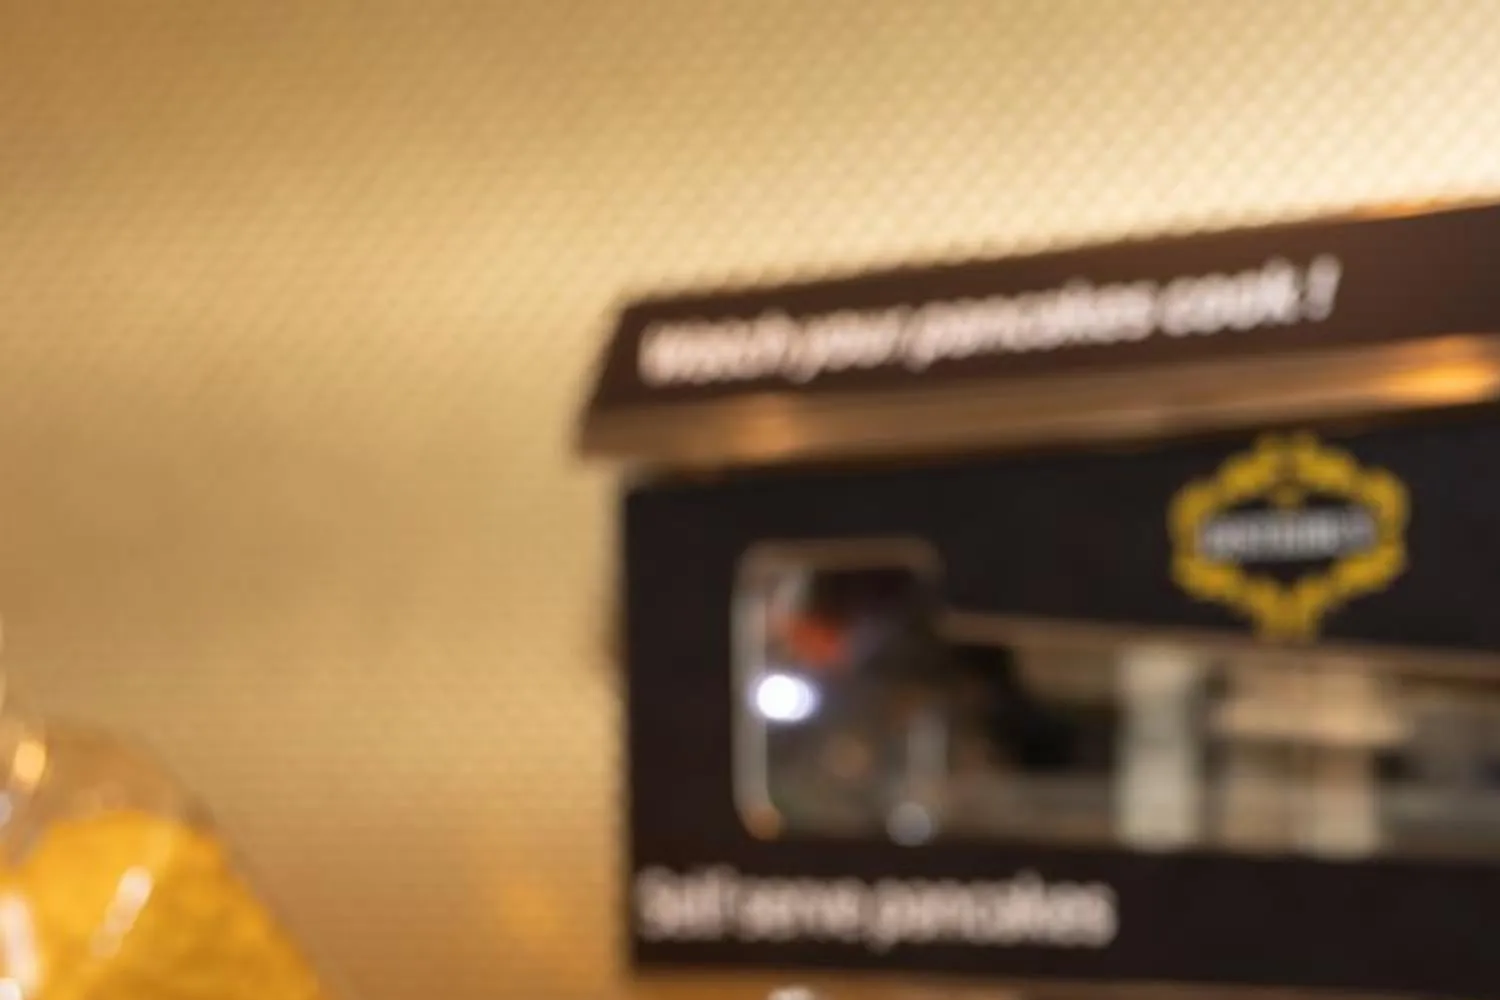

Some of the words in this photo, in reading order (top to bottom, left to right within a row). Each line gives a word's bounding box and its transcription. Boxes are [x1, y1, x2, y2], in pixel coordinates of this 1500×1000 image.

[640, 311, 793, 386] Watch
[790, 306, 908, 383] your
[904, 278, 1158, 372] pancakes
[1159, 255, 1301, 338] cook
[637, 864, 742, 943] Self
[737, 874, 869, 943] serve
[867, 869, 1119, 955] pancakes
